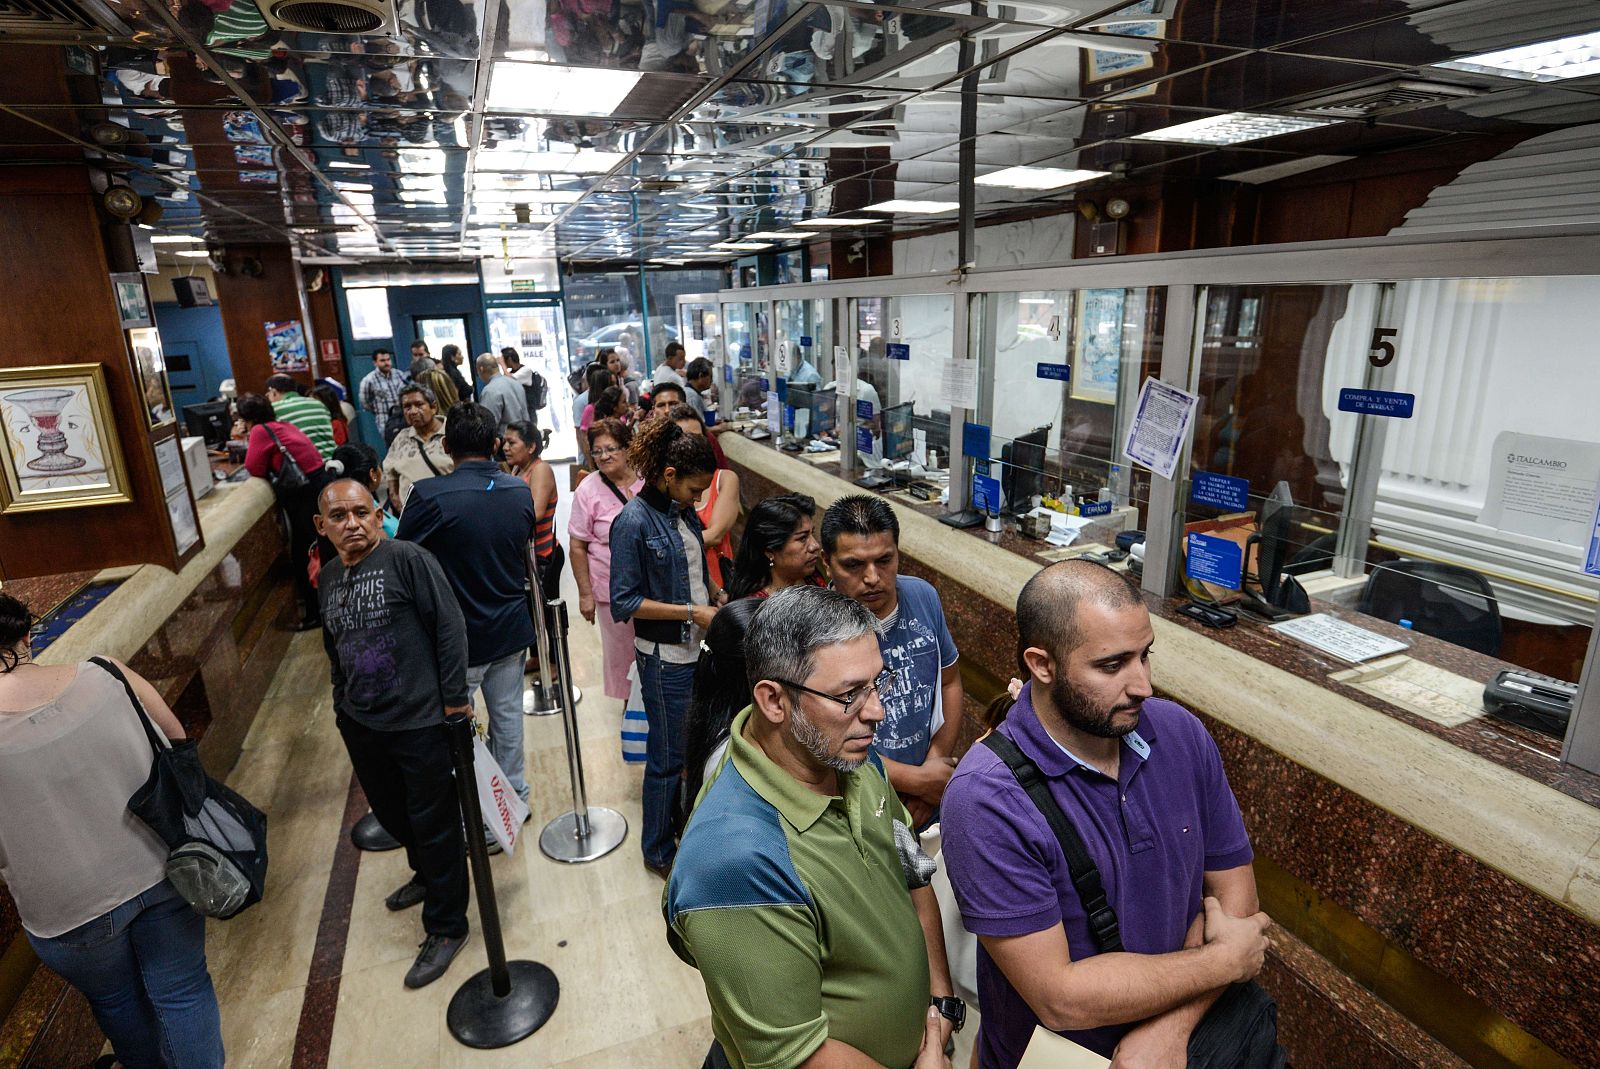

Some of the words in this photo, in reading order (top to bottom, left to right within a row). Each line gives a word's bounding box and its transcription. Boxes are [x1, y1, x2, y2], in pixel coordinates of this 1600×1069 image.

[894, 319, 899, 336] 3
[1047, 315, 1060, 341] 4
[523, 350, 544, 358] HALE
[1369, 328, 1397, 367] 5
[1344, 394, 1373, 402] COMPRA
[1384, 397, 1408, 406] VENTA
[1516, 455, 1567, 468] ITALCAMBIO
